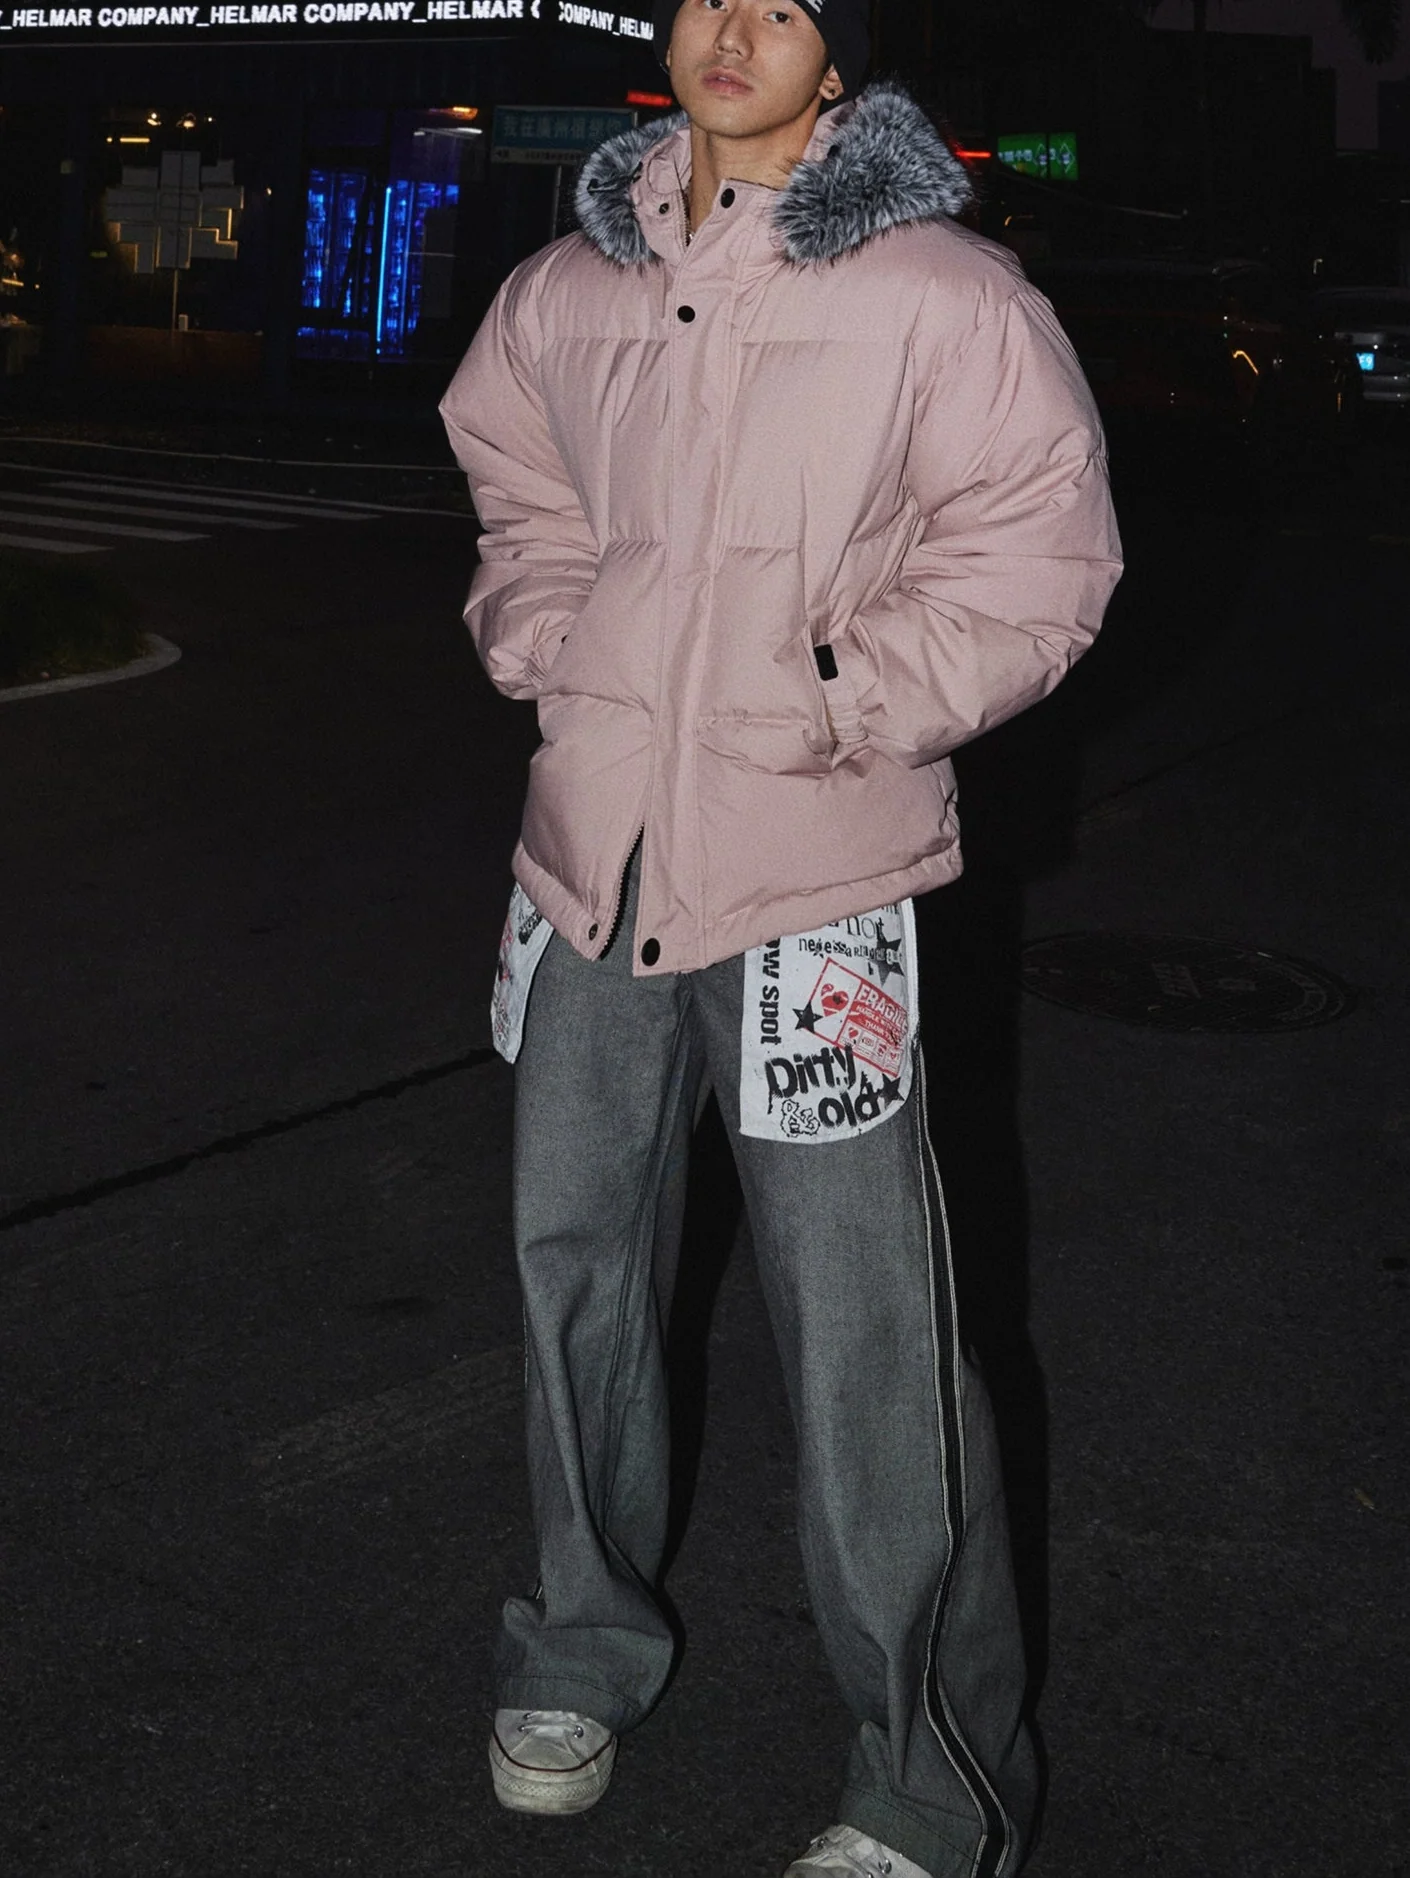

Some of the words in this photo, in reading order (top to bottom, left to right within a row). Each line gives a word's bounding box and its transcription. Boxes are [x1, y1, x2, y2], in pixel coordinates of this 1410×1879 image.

[98, 4, 297, 27] COMPANY_HELMAR
[303, 0, 523, 23] COMPANY_HELMAR
[759, 985, 782, 1046] spot
[764, 1044, 856, 1115] Dirty
[818, 1071, 881, 1127] old
